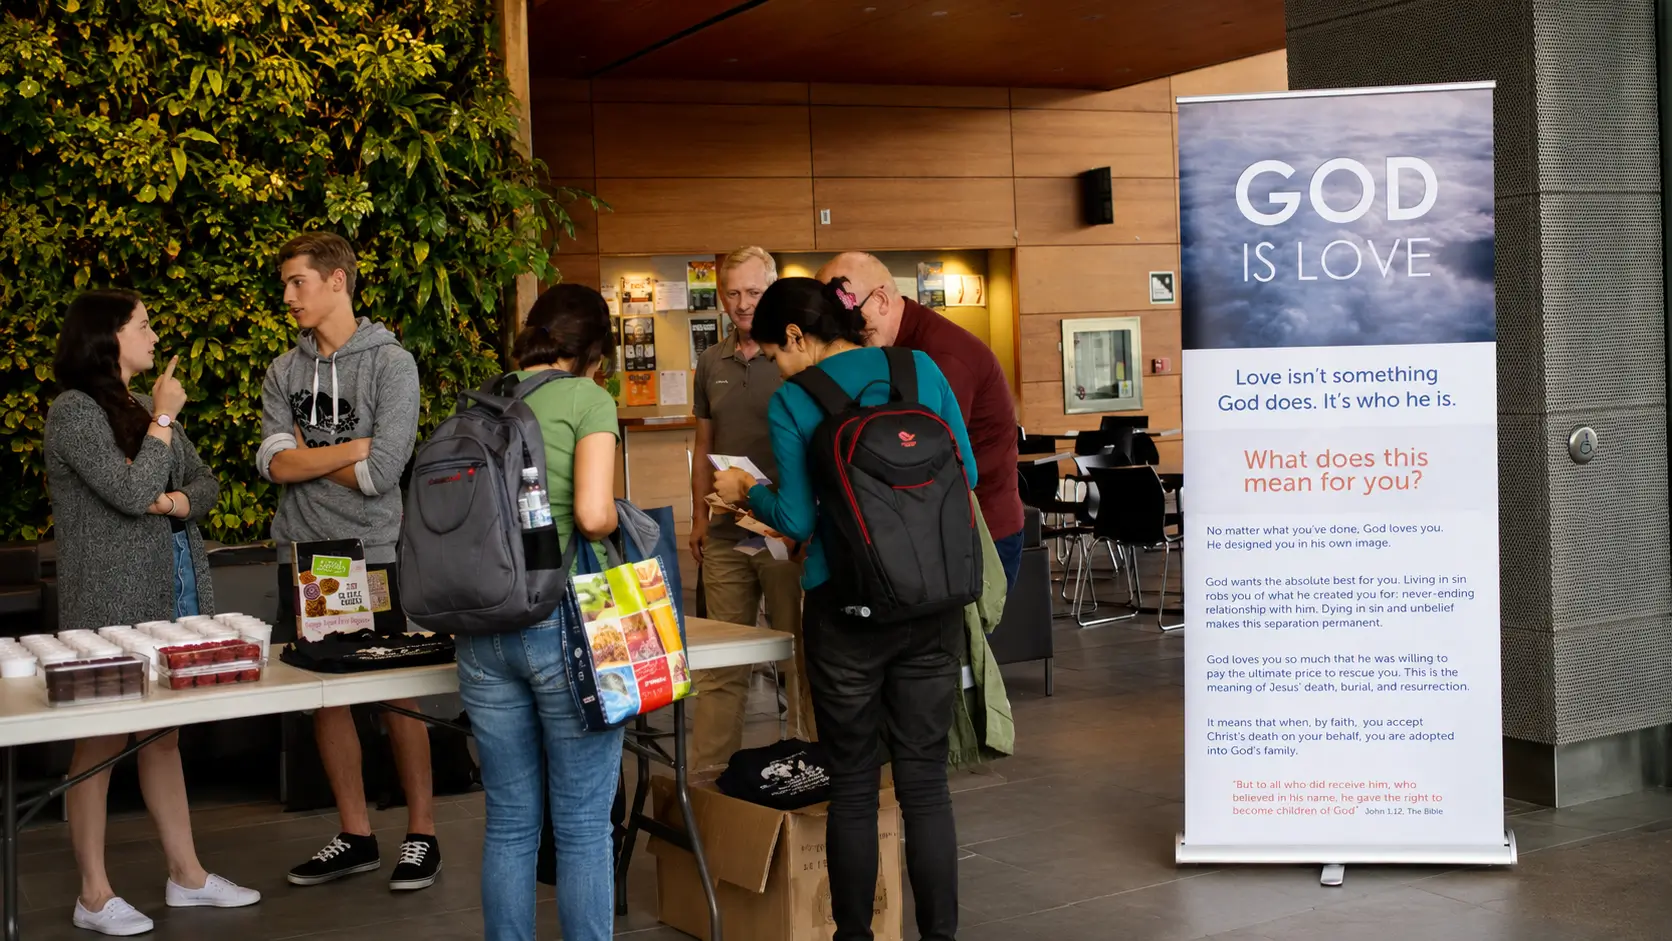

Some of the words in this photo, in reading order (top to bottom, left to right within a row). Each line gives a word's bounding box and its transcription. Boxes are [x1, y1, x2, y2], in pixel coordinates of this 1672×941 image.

[1235, 156, 1438, 226] GOD
[1243, 241, 1276, 282] IS
[1297, 237, 1432, 281] LOVE
[1236, 369, 1282, 385] Love
[1288, 368, 1327, 384] isn't
[1333, 366, 1438, 385] something
[1218, 394, 1259, 411] God
[1265, 394, 1317, 411] does.
[1324, 392, 1351, 409] It's
[1356, 392, 1400, 408] who
[1406, 391, 1430, 407] he
[1437, 390, 1456, 406] is.
[1244, 449, 1308, 469] What
[1316, 449, 1375, 469] does
[1383, 447, 1428, 467] this
[1245, 477, 1312, 492] mean
[1320, 472, 1356, 491] for
[1363, 470, 1422, 495] you?
[1207, 526, 1222, 536] No
[1225, 527, 1260, 535] matter
[1263, 525, 1289, 535] what
[1292, 525, 1327, 536] you've
[1363, 523, 1386, 533] God
[1389, 524, 1418, 533] loves
[1420, 525, 1443, 535] you.
[1207, 540, 1222, 550] He
[1224, 539, 1272, 551] designed
[1275, 541, 1295, 551] you
[1298, 539, 1308, 548] in
[1311, 539, 1326, 548] his
[1328, 540, 1352, 548] own
[1355, 539, 1391, 550] image.
[1205, 577, 1228, 587] God
[1231, 578, 1262, 586] wants
[1265, 577, 1282, 586] the
[1285, 576, 1330, 586] absolute
[1333, 576, 1356, 585] best
[1358, 575, 1374, 585] for
[1377, 577, 1400, 587] you.
[1404, 575, 1435, 586] Living
[1439, 575, 1449, 584] in
[1452, 574, 1467, 584] sin
[1206, 592, 1229, 601] robs
[1231, 593, 1251, 603] you
[1254, 591, 1265, 600] of
[1268, 591, 1294, 600] what
[1297, 590, 1310, 600] he
[1313, 590, 1353, 600] created
[1356, 592, 1376, 601] you
[1380, 589, 1398, 599] for:
[1402, 588, 1474, 600] never-ending
[1205, 604, 1266, 616] relationship
[1269, 604, 1292, 614] with
[1295, 604, 1318, 614] him.
[1322, 604, 1353, 616] Dying
[1356, 604, 1366, 613] in
[1369, 604, 1384, 613] sin
[1387, 603, 1407, 613] and
[1410, 603, 1454, 613] unbelief
[1206, 620, 1240, 629] makes
[1242, 619, 1261, 628] this
[1264, 618, 1319, 630] separation
[1322, 619, 1383, 630] permanent.
[1206, 655, 1229, 664] God
[1232, 655, 1260, 664] loves
[1262, 656, 1282, 666] you
[1285, 656, 1297, 664] so
[1300, 654, 1331, 664] much
[1334, 654, 1355, 663] that
[1358, 654, 1371, 663] he
[1374, 655, 1395, 663] was
[1398, 653, 1434, 665] willing
[1436, 654, 1448, 663] to
[1207, 671, 1226, 680] pay
[1228, 669, 1245, 678] the
[1248, 668, 1292, 678] ultimate
[1295, 669, 1322, 680] price
[1325, 669, 1336, 678] to
[1339, 670, 1375, 678] rescue
[1378, 670, 1401, 679] you.
[1404, 667, 1426, 677] This
[1429, 668, 1438, 677] is
[1441, 668, 1458, 677] the
[1207, 683, 1252, 694] meaning
[1255, 682, 1266, 692] of
[1269, 682, 1301, 692] Jesus'
[1304, 682, 1337, 692] death,
[1341, 682, 1373, 692] burial,
[1377, 682, 1397, 691] and
[1400, 681, 1470, 691] resurrection.
[1207, 718, 1214, 727] It
[1217, 719, 1252, 727] means
[1255, 718, 1276, 727] that
[1279, 718, 1311, 727] when,
[1315, 718, 1328, 729] by
[1330, 717, 1357, 727] faith,
[1363, 719, 1383, 729] you
[1386, 718, 1423, 728] accept
[1207, 731, 1246, 741] Christ's
[1248, 732, 1278, 741] death
[1298, 734, 1323, 743] your
[1326, 731, 1362, 741] behalf,
[1365, 733, 1385, 743] you
[1388, 733, 1406, 741] are
[1409, 731, 1454, 742] adopted
[1207, 746, 1228, 755] into
[1230, 746, 1261, 755] God's
[1264, 746, 1298, 757] family.
[1256, 781, 1267, 789] to
[1269, 780, 1281, 789] all
[1284, 780, 1307, 789] who
[1309, 780, 1325, 789] did
[1328, 781, 1365, 789] receive
[1368, 780, 1390, 790] him,
[1394, 780, 1417, 789] who
[1232, 793, 1274, 802] believed
[1277, 793, 1287, 802] in
[1289, 793, 1304, 802] his
[1341, 793, 1354, 802] he
[1356, 795, 1381, 804] gave
[1384, 793, 1401, 802] the
[1404, 793, 1428, 804] right
[1432, 794, 1443, 802] to
[1232, 806, 1274, 815] become
[1276, 806, 1317, 815] children
[1320, 806, 1330, 815] of
[1365, 807, 1385, 815] John
[1407, 807, 1422, 815] The
[1424, 807, 1444, 815] Bible
